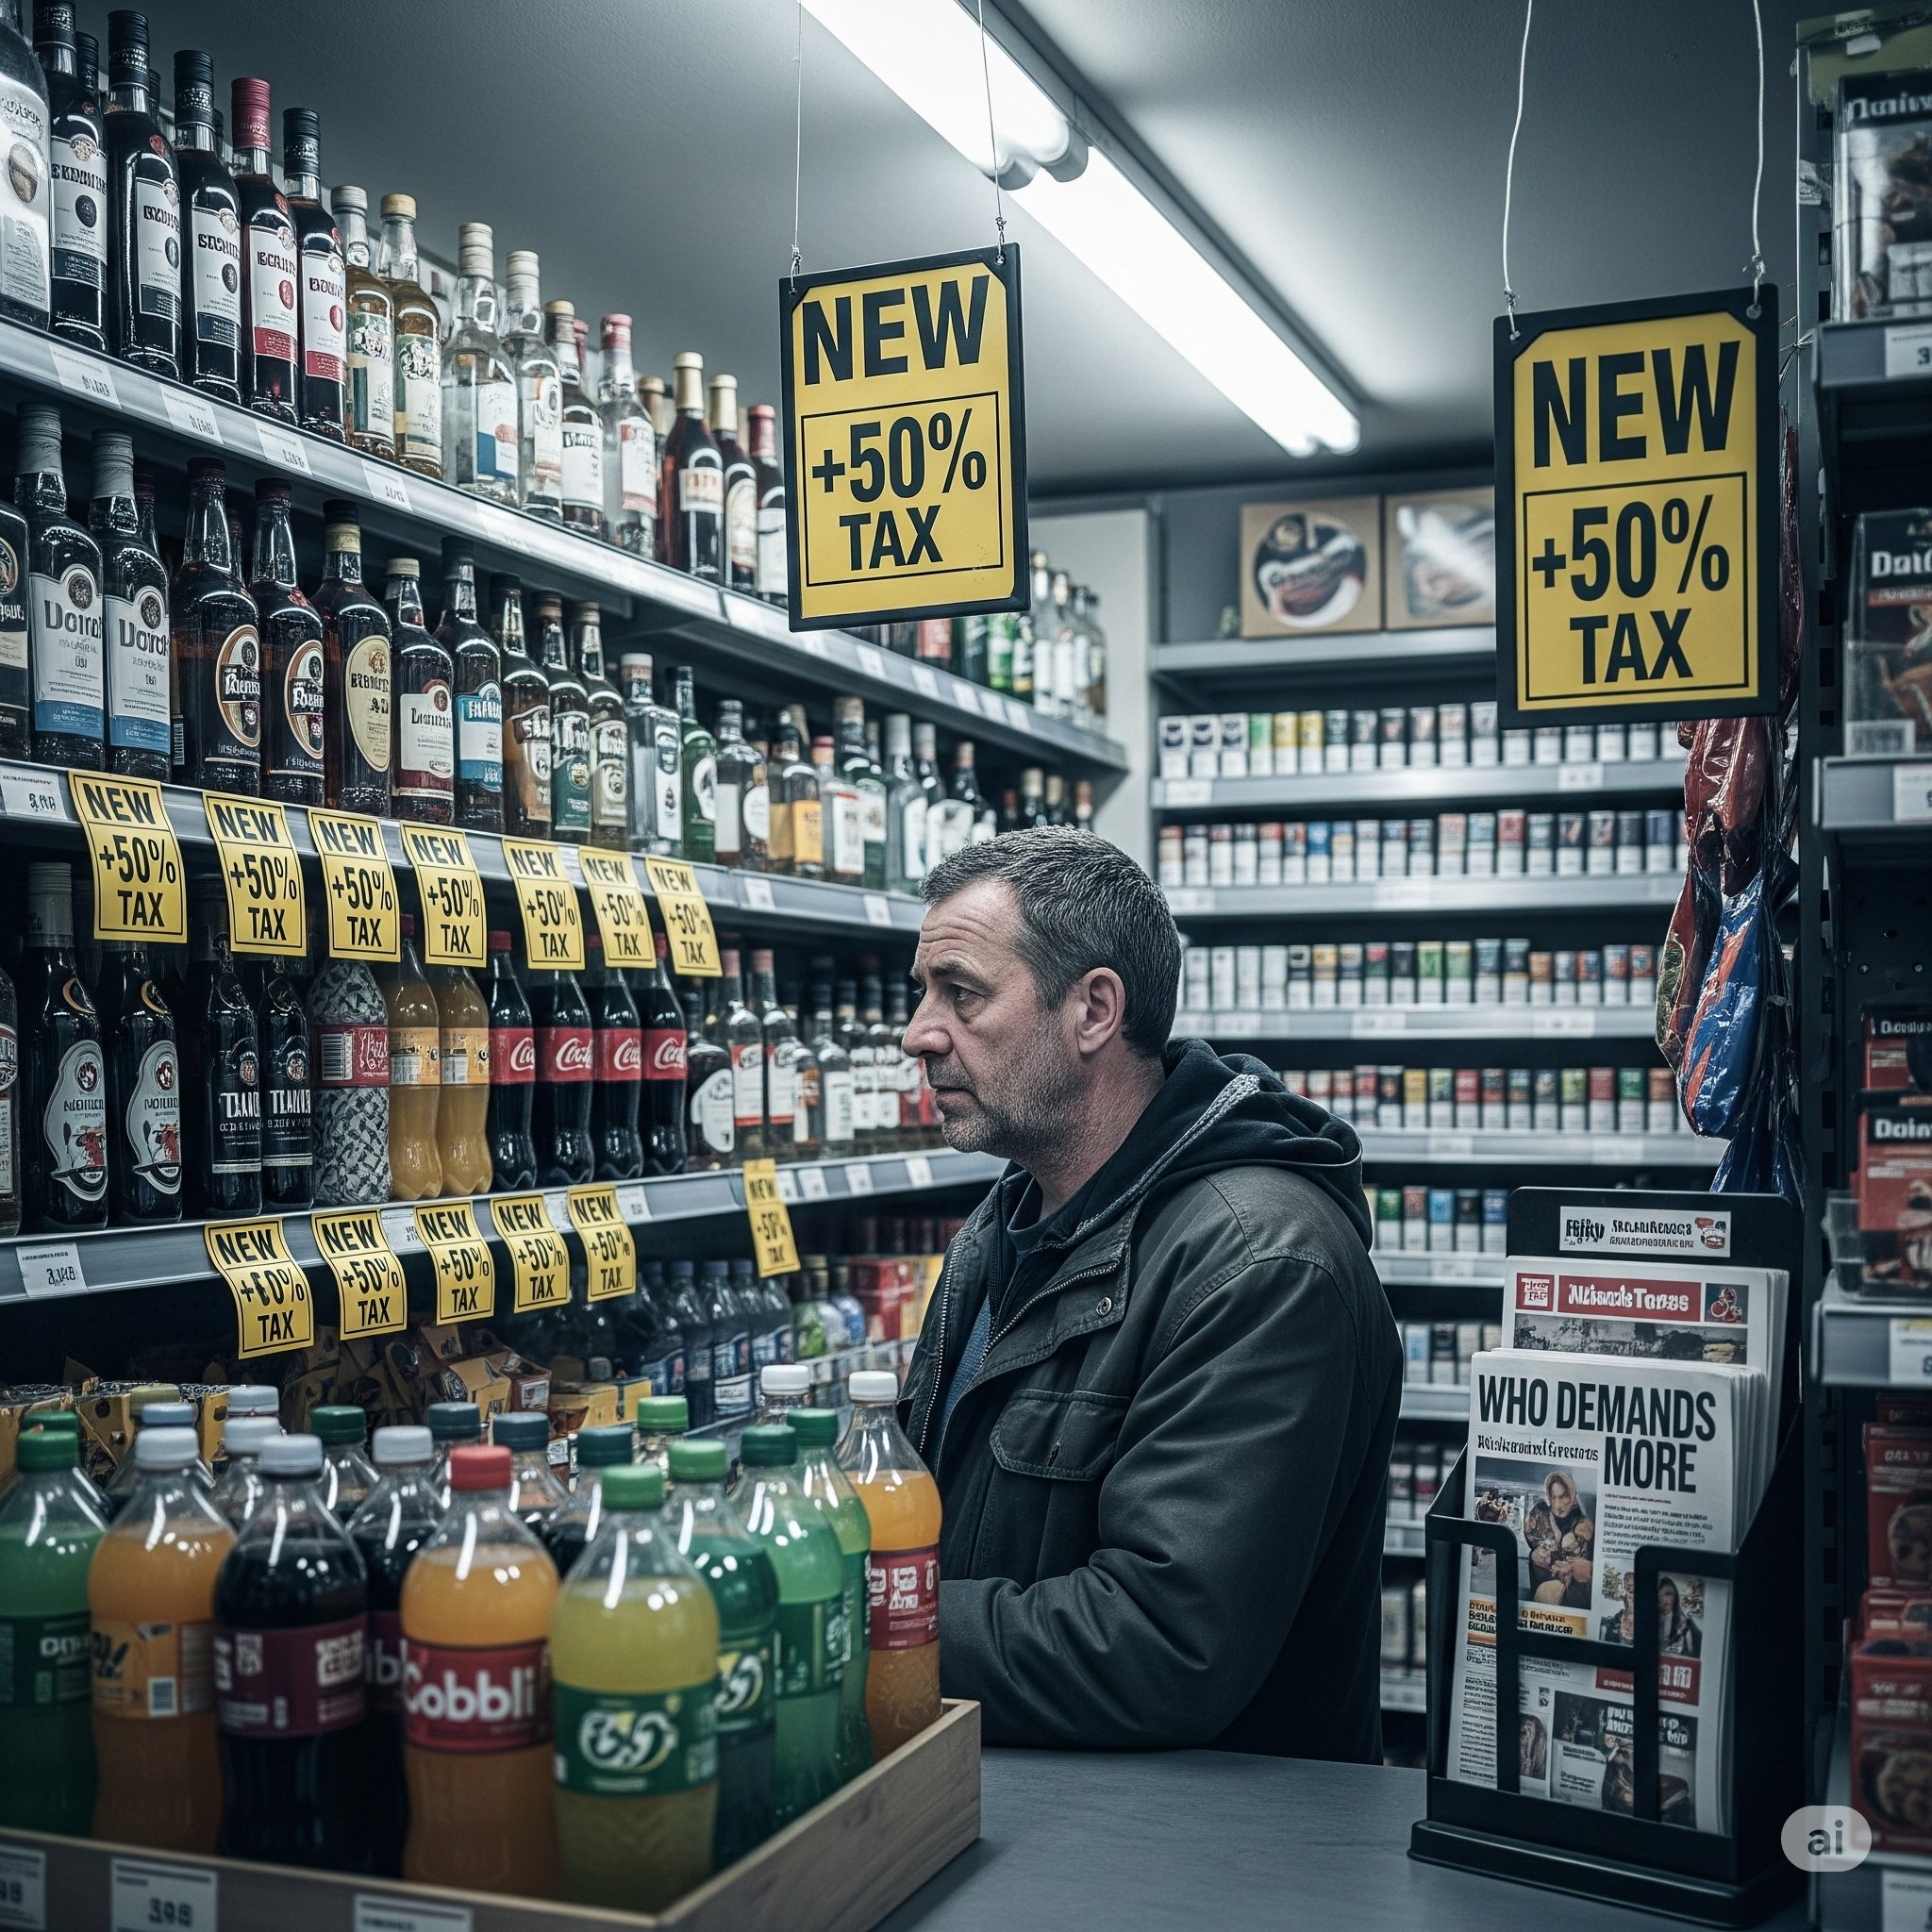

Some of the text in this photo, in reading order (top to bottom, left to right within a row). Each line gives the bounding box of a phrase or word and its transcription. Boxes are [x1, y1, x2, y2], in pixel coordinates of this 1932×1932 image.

[802, 275, 990, 386] NEW
[1532, 340, 1741, 469] NEW
[812, 408, 987, 503] +50%
[840, 505, 943, 572] TAX
[1532, 493, 1730, 602] +50%
[1570, 608, 1694, 685] TAX
[83, 783, 157, 824] NEW
[213, 804, 280, 843] NEW
[318, 820, 377, 856] NEW
[99, 834, 176, 884] +50%
[410, 833, 465, 866] NEW
[509, 848, 558, 876] NEW
[231, 853, 297, 901] +50%
[332, 866, 392, 911] +50%
[585, 858, 627, 883] NEW
[654, 867, 692, 892] NEW
[117, 890, 165, 927] TAX
[427, 876, 479, 918] +50%
[526, 890, 575, 926] +50%
[247, 907, 287, 941] TAX
[347, 916, 382, 947] TAX
[441, 924, 472, 954] TAX
[540, 932, 570, 958] TAX
[613, 932, 641, 956] TAX
[680, 941, 707, 964] TAX
[420, 1209, 472, 1241] NEW
[498, 1203, 544, 1233] NEW
[574, 1195, 614, 1224] NEW
[215, 1229, 278, 1265] NEW
[321, 1219, 379, 1254] NEW
[517, 1236, 564, 1272] +50%
[342, 1257, 399, 1294] +50%
[441, 1246, 490, 1282] +50%
[600, 1266, 624, 1291] TAX
[451, 1286, 479, 1313] TAX
[529, 1274, 555, 1301] TAX
[258, 1309, 294, 1343] TAX
[358, 1296, 390, 1327] TAX
[1478, 1374, 1717, 1442] WHO DEMANDS
[1604, 1436, 1698, 1494] MORE
